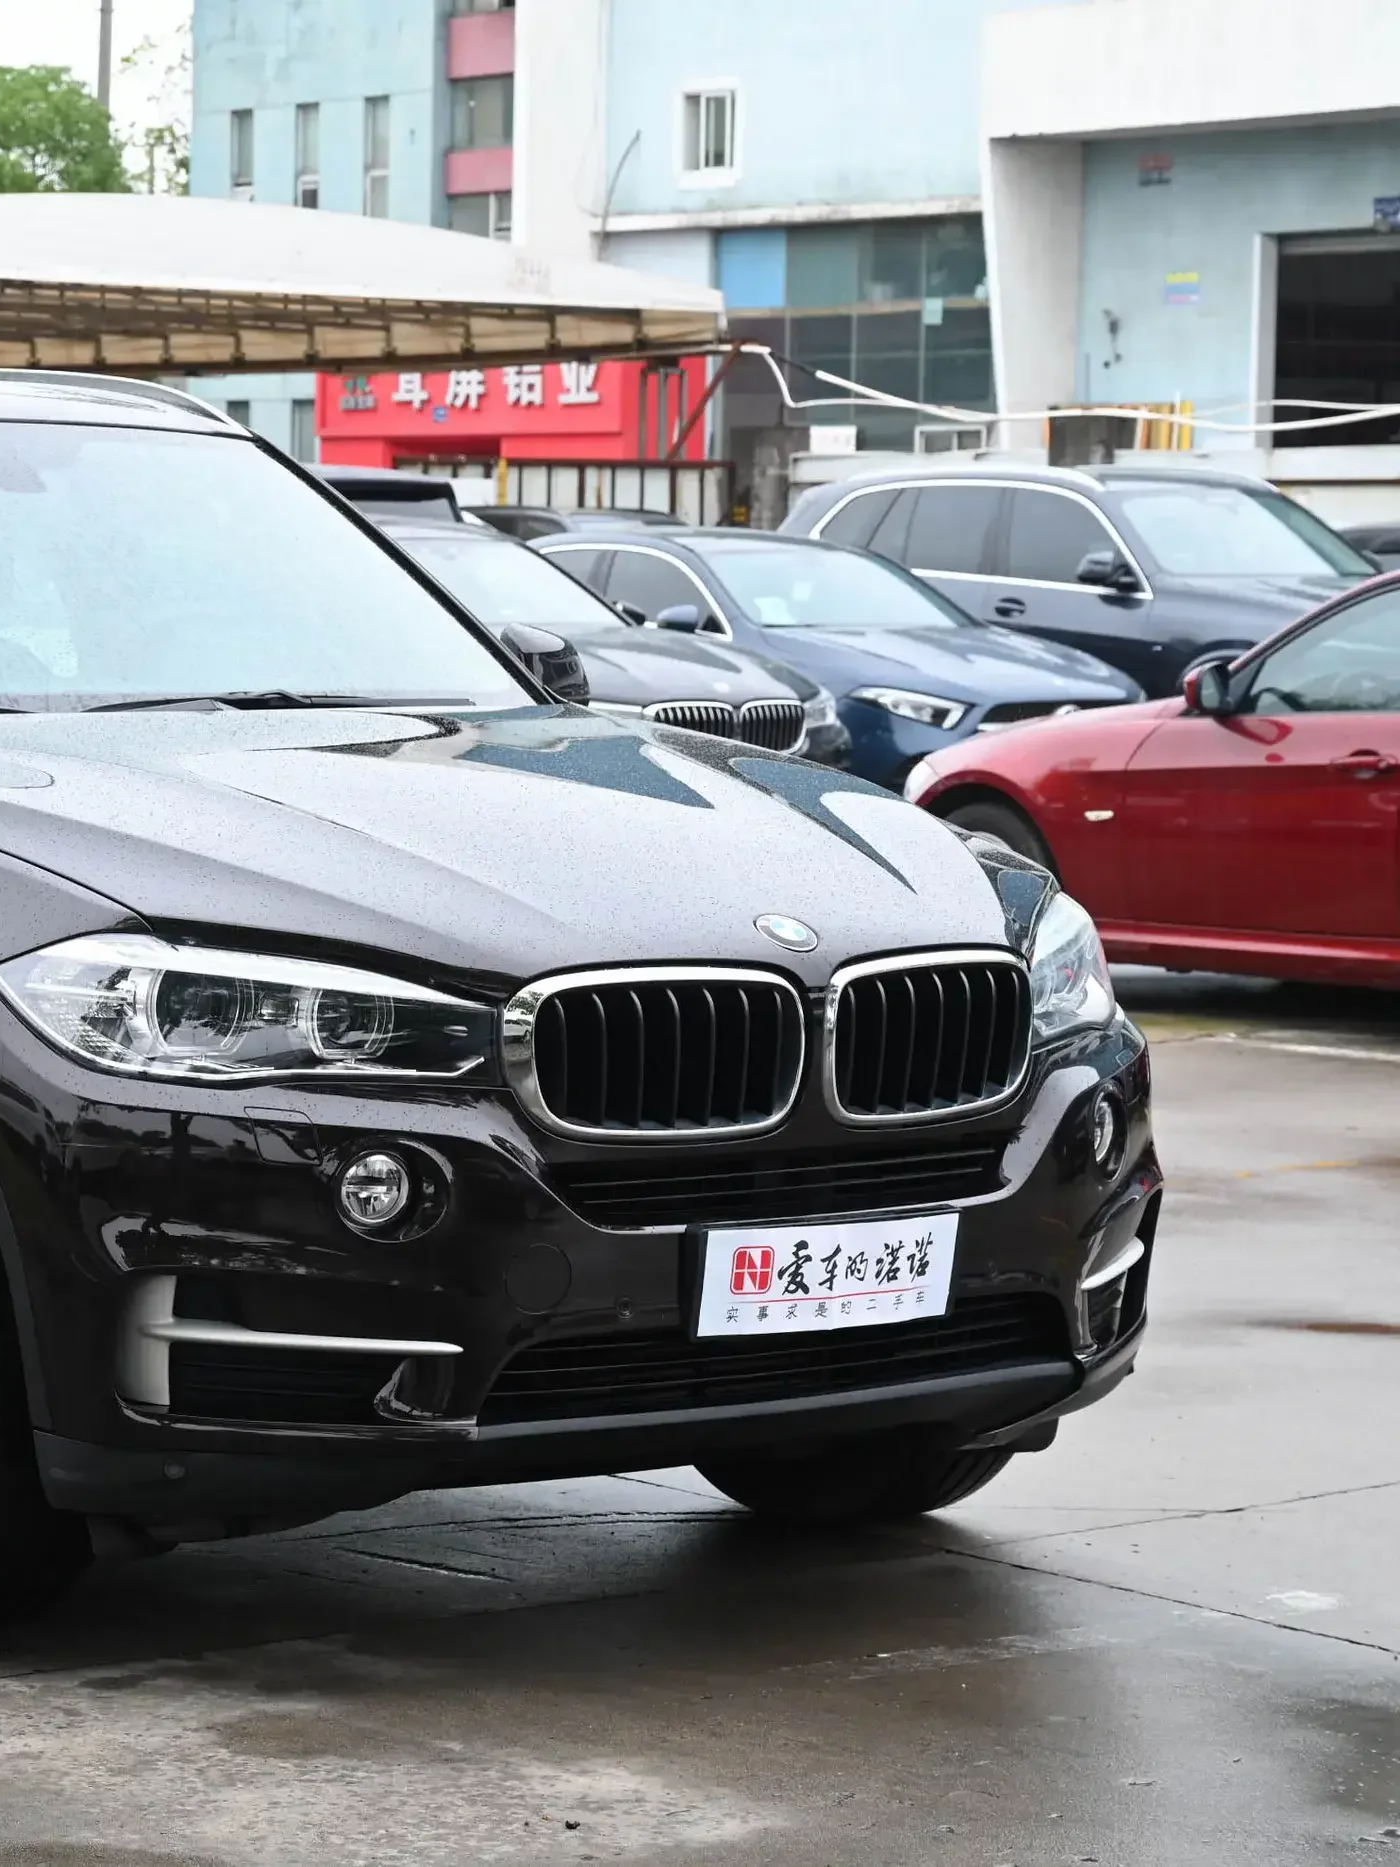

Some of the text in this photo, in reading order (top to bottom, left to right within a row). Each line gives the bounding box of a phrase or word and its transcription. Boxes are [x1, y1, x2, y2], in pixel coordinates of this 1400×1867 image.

[777, 1232, 934, 1296] 爱车的诺诺
[724, 1290, 926, 1323] 实事求是的二手车
